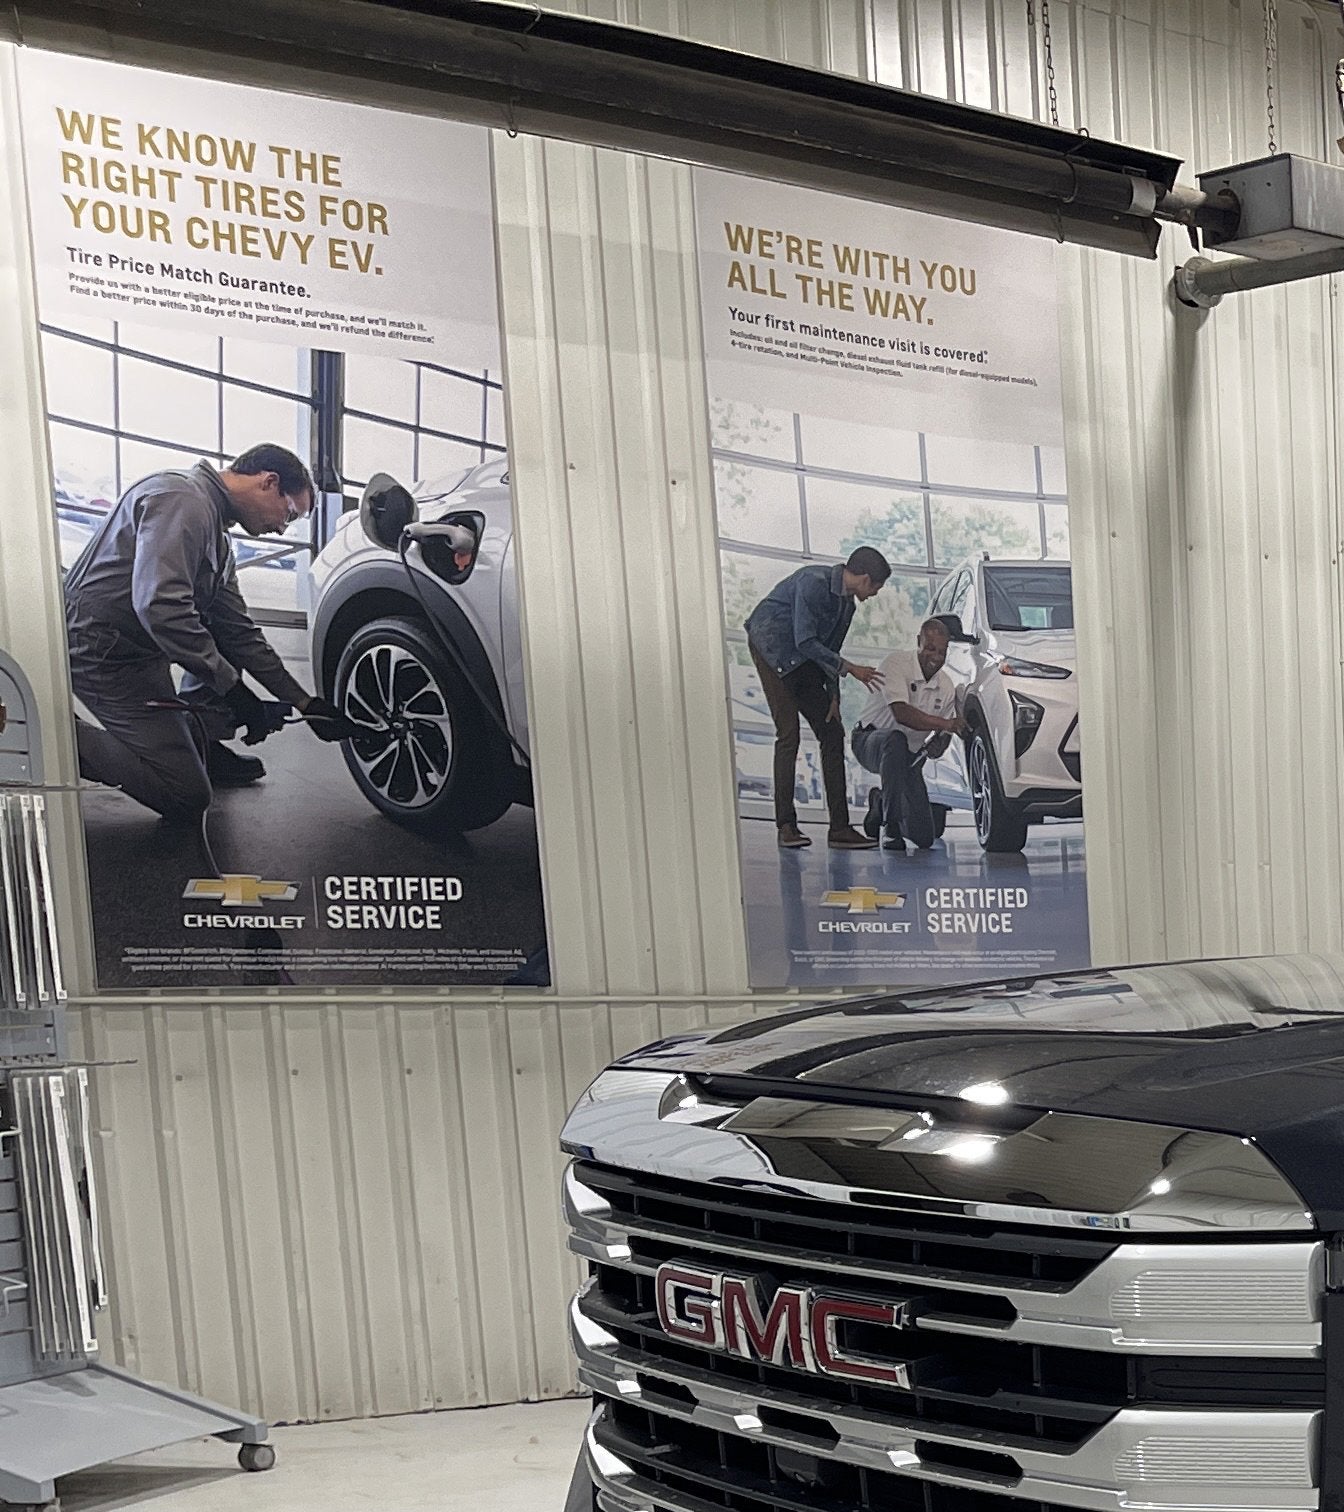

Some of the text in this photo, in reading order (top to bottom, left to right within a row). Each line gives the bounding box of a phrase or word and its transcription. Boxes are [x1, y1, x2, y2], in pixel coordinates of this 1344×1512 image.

[56, 107, 342, 188] WE KNOW THE
[60, 151, 389, 236] RIGHT TIRES FOR
[61, 193, 384, 276] YOUR CHEVY EV.
[724, 221, 977, 295] WE'RE WITH YOU
[66, 246, 312, 299] Tire Price Match Guarantee.
[727, 261, 934, 325] ALL THE WAY.
[728, 306, 761, 325] Your
[765, 313, 796, 332] first
[800, 323, 885, 348] maintenance
[888, 337, 916, 354] visit
[920, 340, 930, 356] is
[324, 875, 464, 902] CERTIFIED
[925, 887, 1028, 910] CERTIFIED
[183, 913, 306, 930] CHEVROLET
[326, 905, 442, 931] SERVICE
[817, 921, 912, 934] CHEVROLET
[926, 913, 1013, 934] SERVICE
[655, 1258, 911, 1390] GMC
